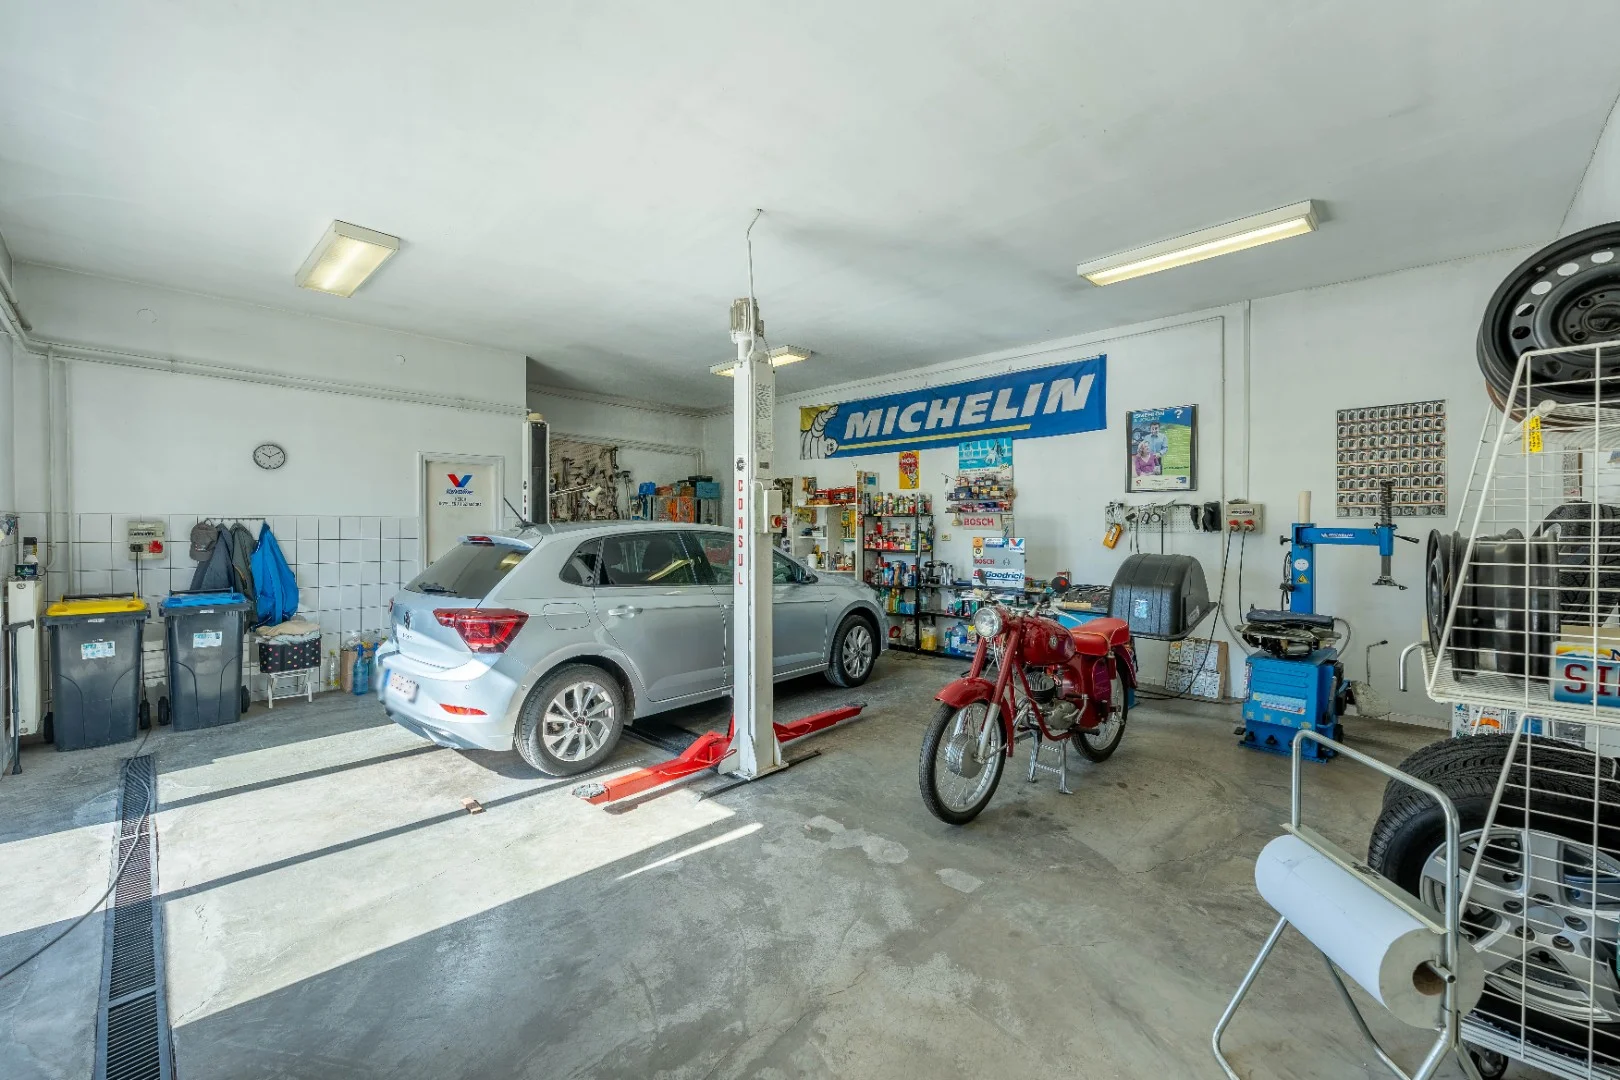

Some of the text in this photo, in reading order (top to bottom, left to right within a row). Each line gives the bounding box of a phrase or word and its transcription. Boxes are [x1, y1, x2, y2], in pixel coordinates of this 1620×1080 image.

[843, 373, 1096, 440] MICHELIN
[963, 517, 995, 526] BOSCH
[1564, 663, 1620, 697] SI
